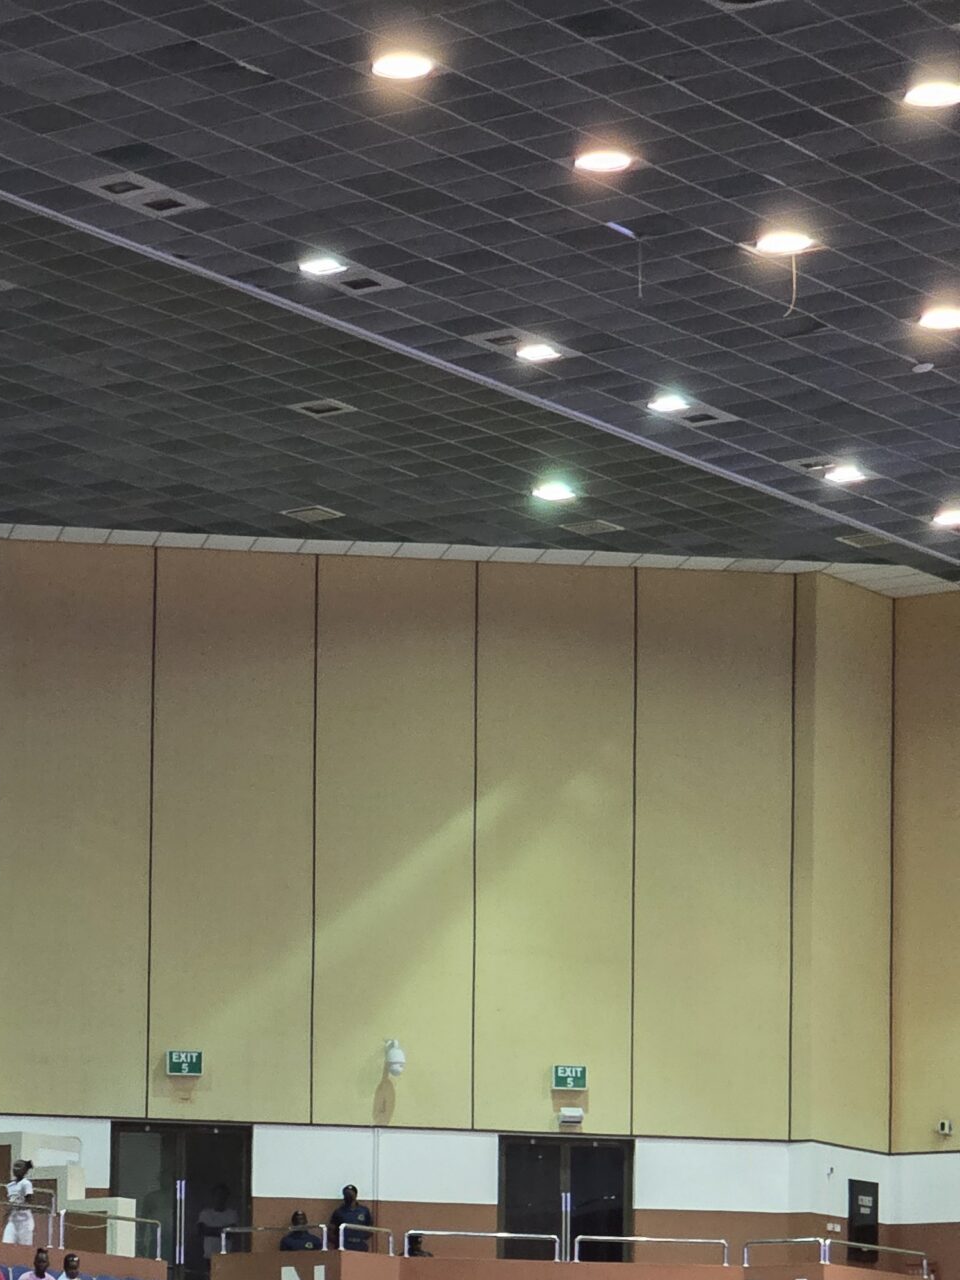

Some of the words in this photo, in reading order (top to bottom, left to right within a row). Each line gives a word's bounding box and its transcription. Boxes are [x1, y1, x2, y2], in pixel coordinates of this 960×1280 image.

[172, 1052, 199, 1063] EXIT
[181, 1063, 189, 1073] 5
[557, 1066, 583, 1077] EXIT
[566, 1077, 574, 1087] 5
